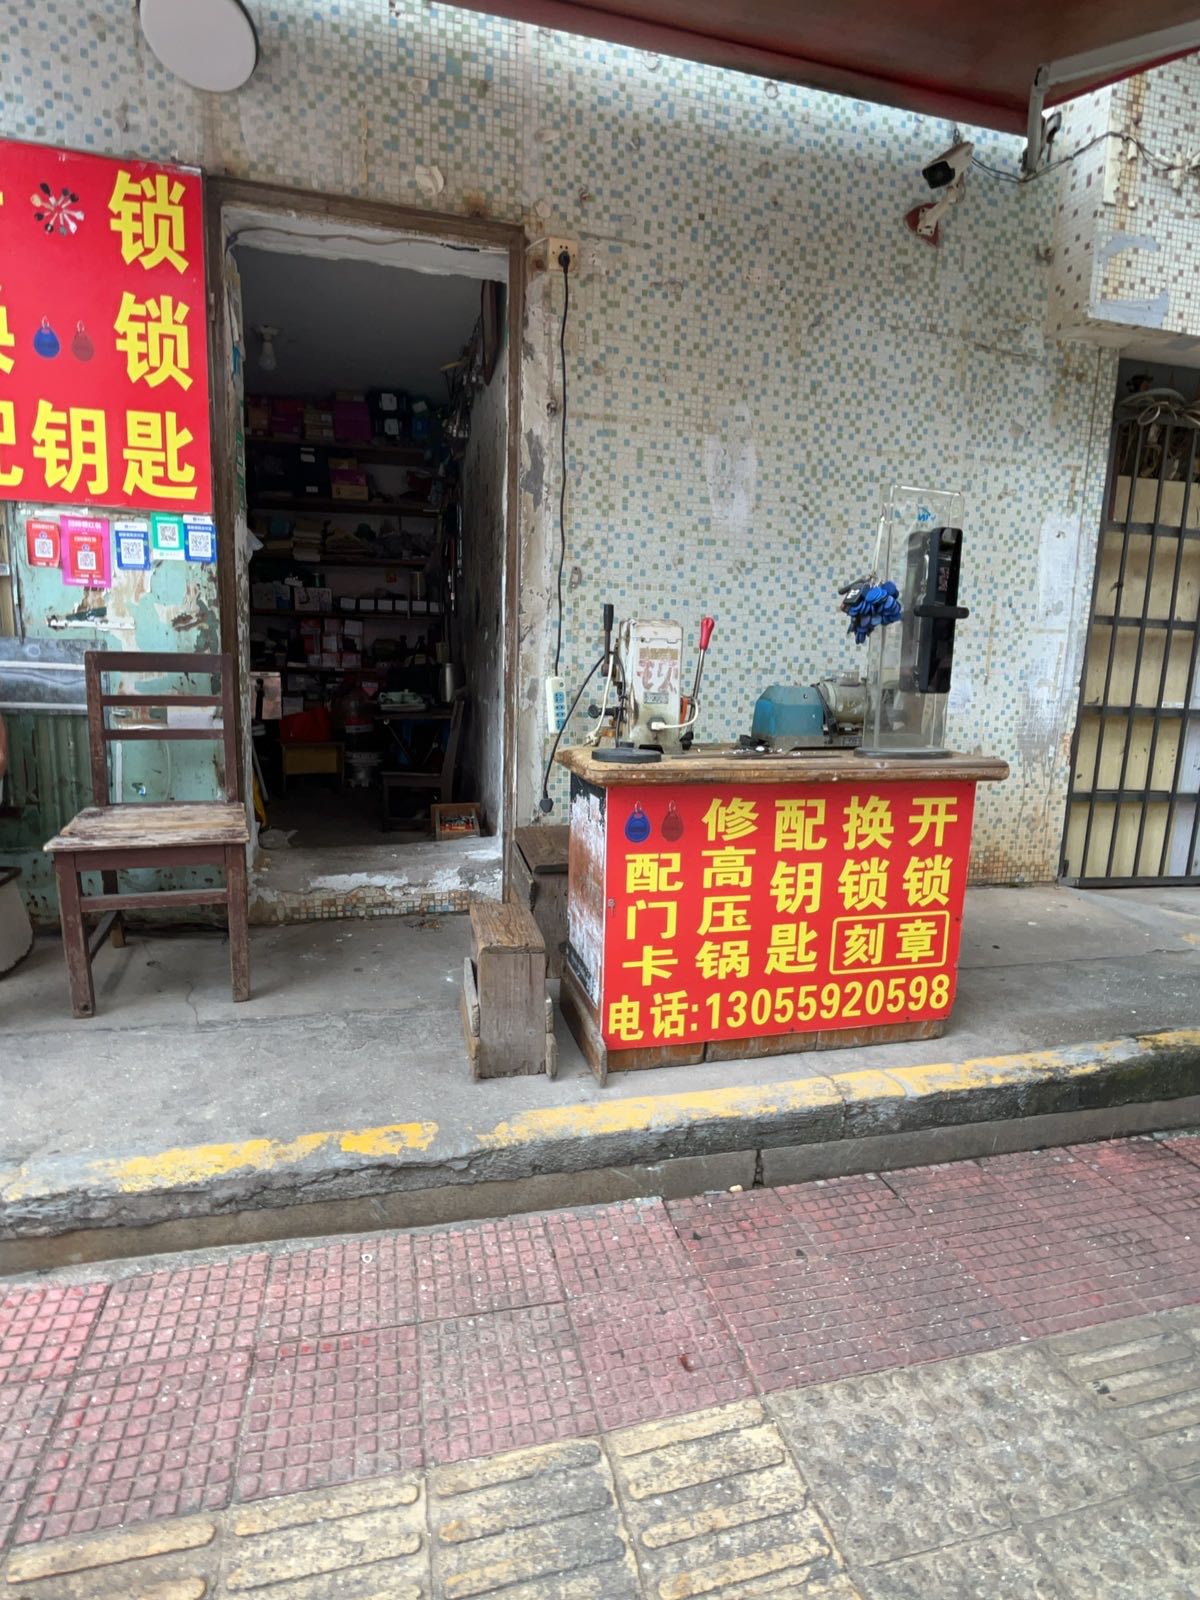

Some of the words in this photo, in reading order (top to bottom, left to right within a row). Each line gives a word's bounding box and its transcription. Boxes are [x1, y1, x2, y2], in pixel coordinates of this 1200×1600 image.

[696, 798, 759, 980] 修高压锅
[765, 799, 827, 976] 配钥匙
[838, 796, 894, 911] 换锁
[902, 797, 958, 907] 开锁
[623, 853, 684, 986] 配门卡
[843, 919, 938, 967] 刻章
